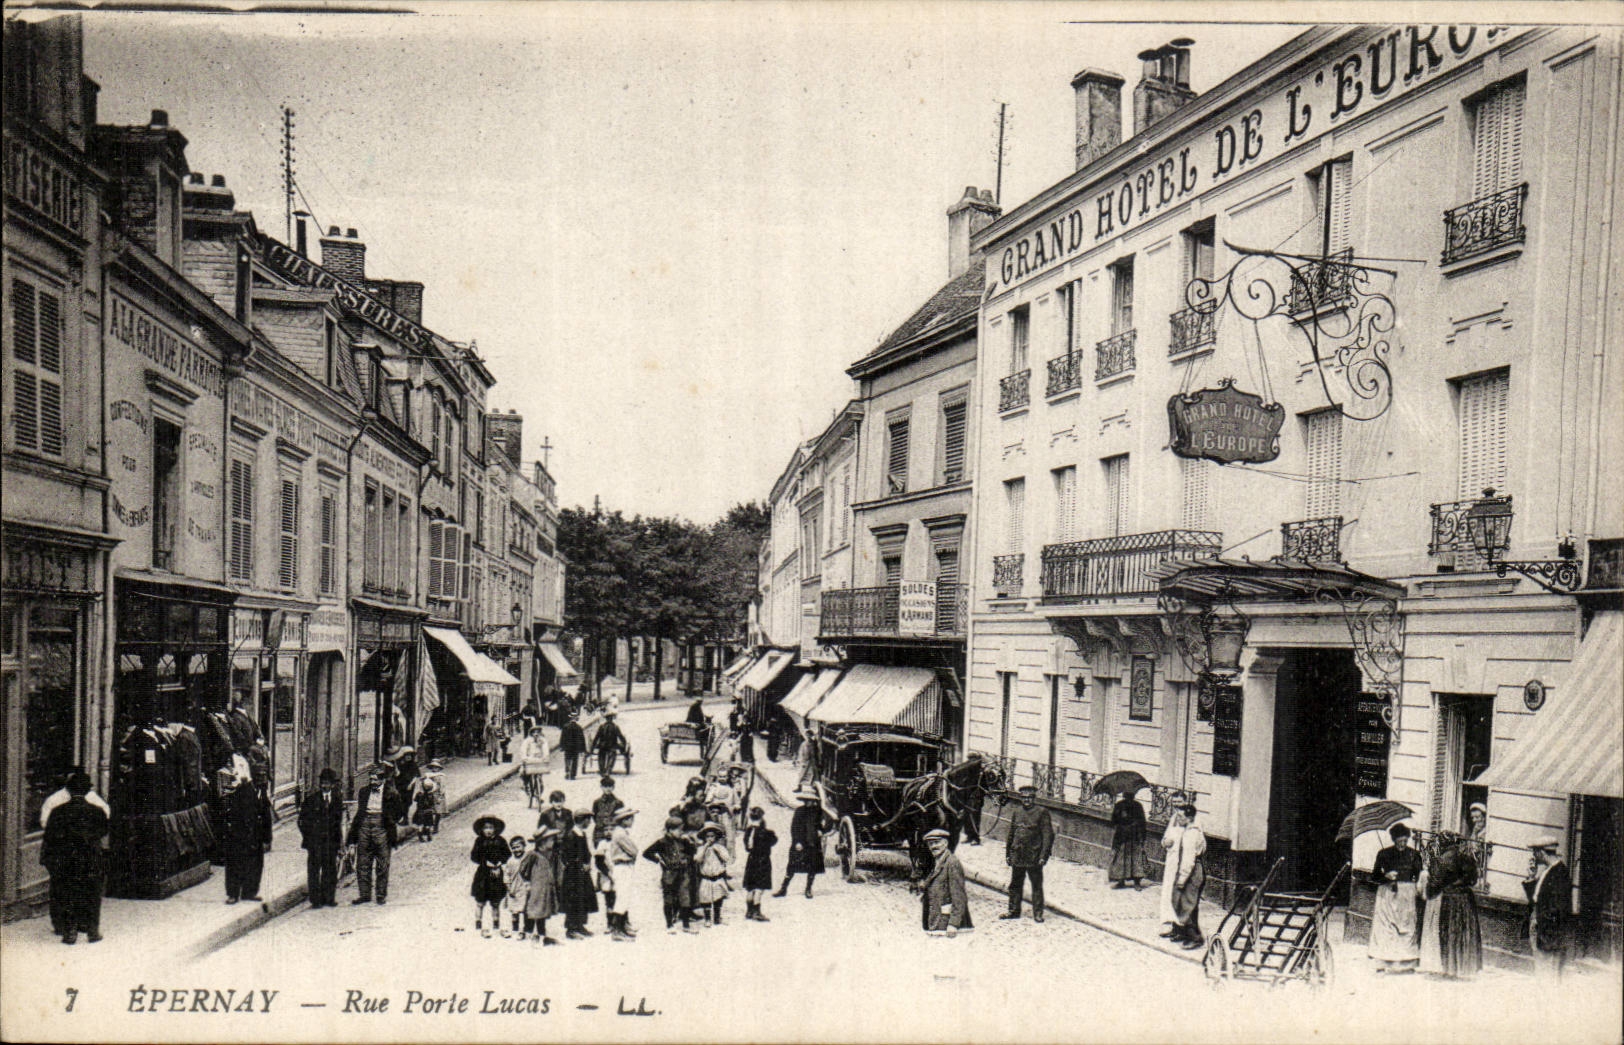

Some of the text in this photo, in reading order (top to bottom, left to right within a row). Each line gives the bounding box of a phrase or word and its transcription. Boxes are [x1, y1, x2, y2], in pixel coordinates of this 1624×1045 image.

[1001, 208, 1084, 286] GRAND
[1212, 108, 1264, 179] DE
[1182, 402, 1227, 424] GRAND
[902, 583, 935, 597] SOLDES
